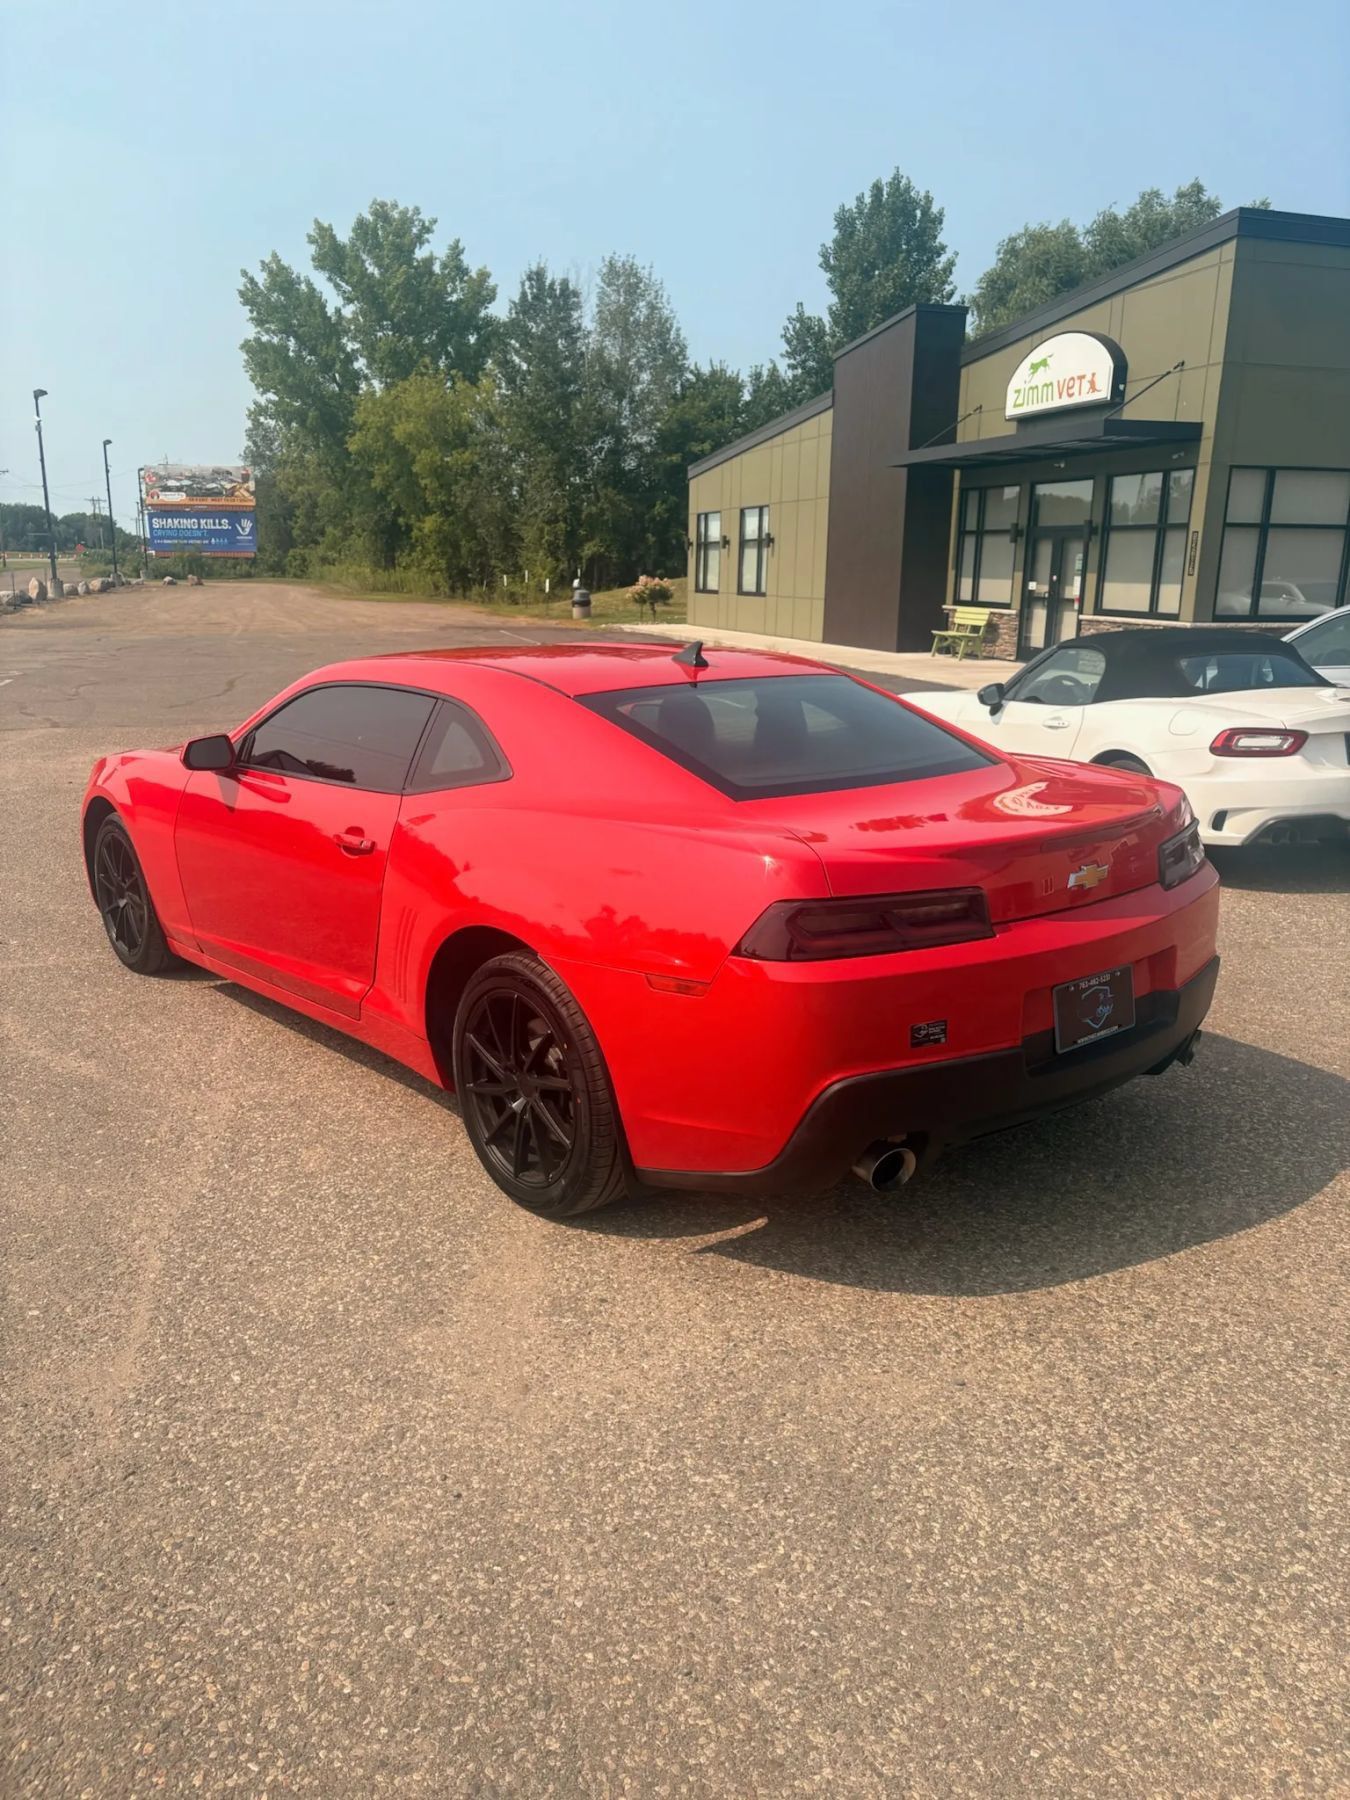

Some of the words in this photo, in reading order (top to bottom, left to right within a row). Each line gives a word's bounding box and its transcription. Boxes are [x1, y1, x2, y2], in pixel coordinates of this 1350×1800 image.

[152, 518, 199, 529] SHAKING
[200, 518, 232, 530] KILLS.
[153, 529, 178, 537] CRYING
